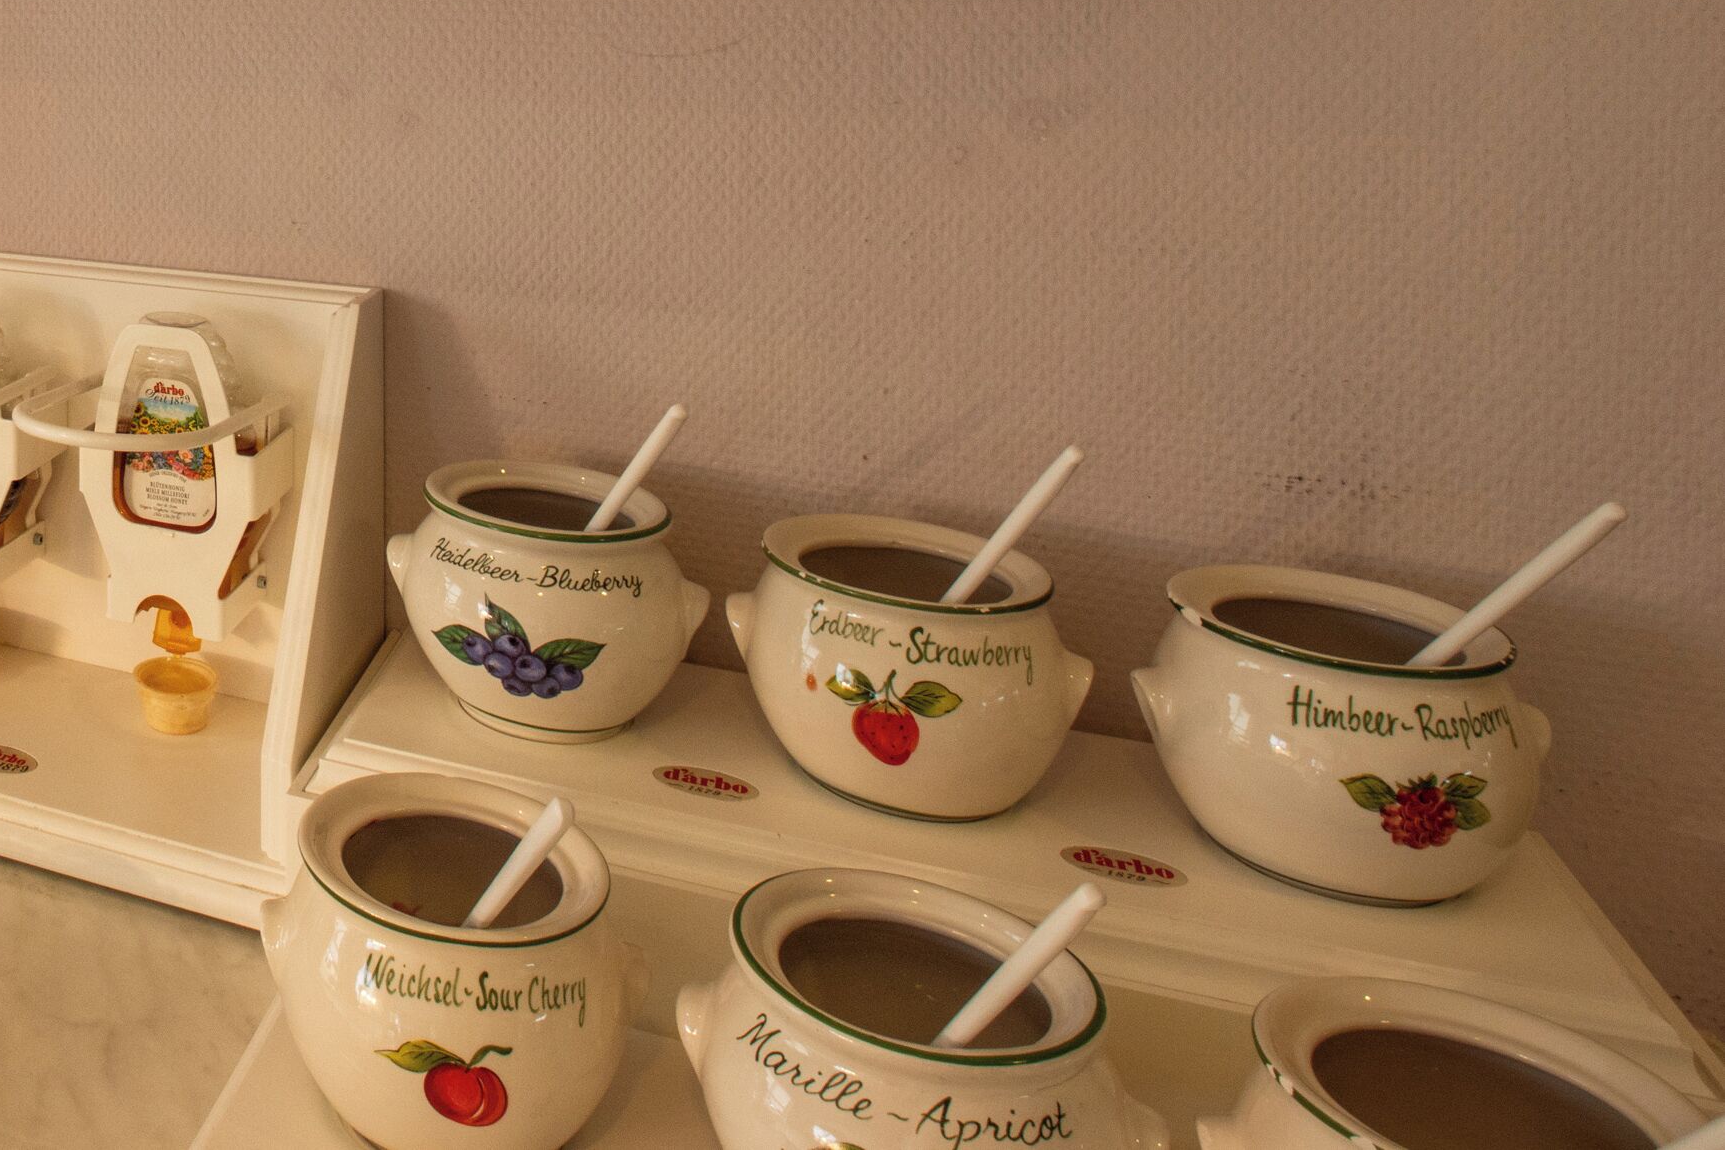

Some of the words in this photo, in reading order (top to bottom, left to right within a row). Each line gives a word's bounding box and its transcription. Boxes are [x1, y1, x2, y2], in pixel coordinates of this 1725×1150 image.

[170, 395, 190, 405] 1879
[809, 599, 884, 647] Erdbeer
[905, 626, 1033, 686] Strawberry
[528, 976, 586, 1028] Cherry
[736, 1013, 873, 1121] Marille
[916, 1096, 1073, 1150] Apricot
